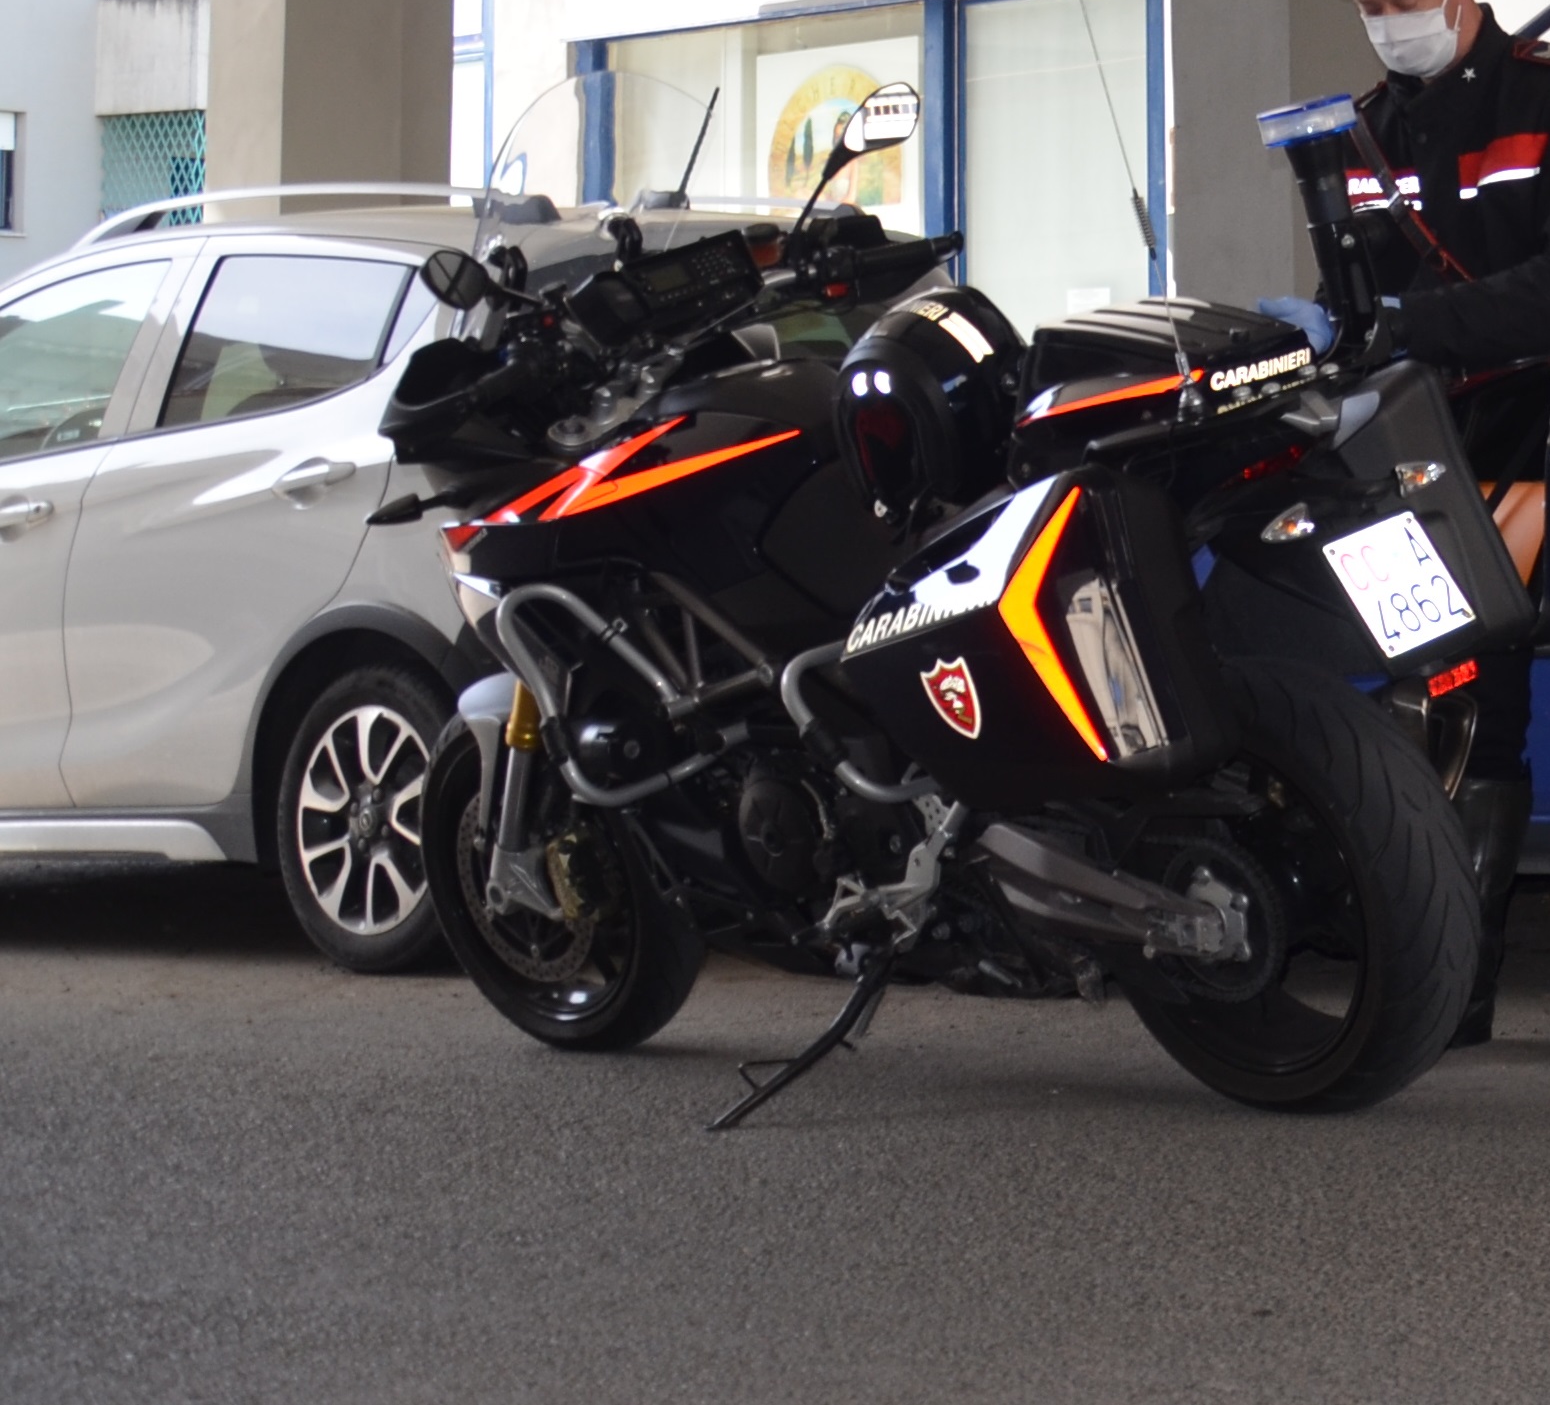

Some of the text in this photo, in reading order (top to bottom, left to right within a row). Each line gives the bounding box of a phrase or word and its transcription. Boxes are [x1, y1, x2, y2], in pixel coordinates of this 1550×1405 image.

[1210, 347, 1311, 391] CARABINIERI
[1404, 527, 1432, 566] A
[1377, 575, 1465, 639] 4862
